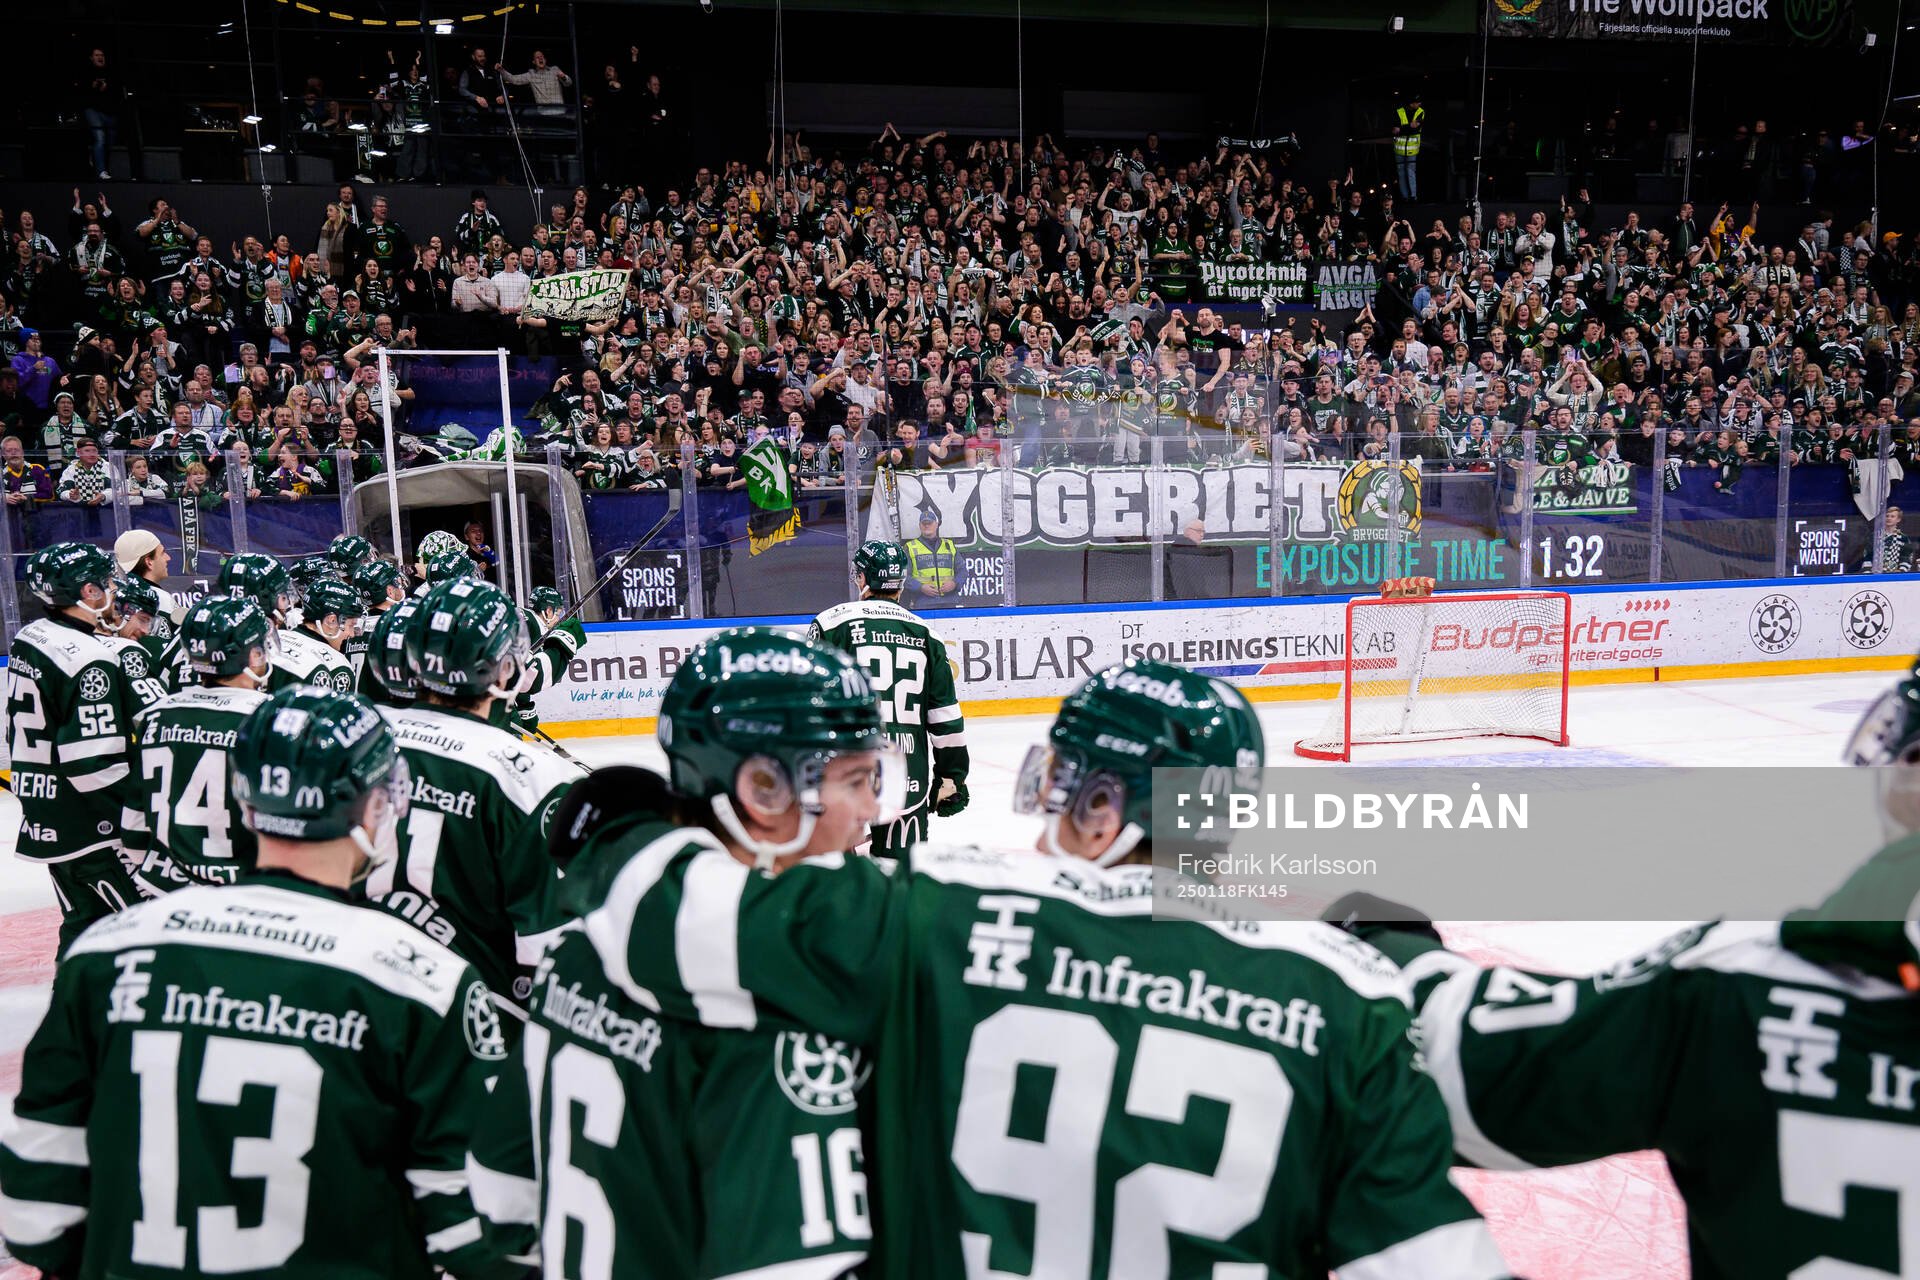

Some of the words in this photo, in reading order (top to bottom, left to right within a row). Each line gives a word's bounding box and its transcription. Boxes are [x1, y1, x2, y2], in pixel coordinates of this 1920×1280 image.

[1599, 22, 1640, 33] Färjestads
[1641, 24, 1673, 35] officiella
[1674, 27, 1731, 36] supporterklubb
[1199, 261, 1307, 284] Pyroteknik
[1318, 261, 1377, 286] AVGÅ
[537, 272, 622, 299] KARLSTAD
[1207, 283, 1224, 297] är
[1228, 284, 1263, 300] inget
[1267, 283, 1304, 298] brott
[1554, 489, 1569, 507] &
[1800, 530, 1840, 549] SPONS
[965, 557, 1004, 576] PONS
[1431, 539, 1506, 581] TIME
[1540, 535, 1604, 578] 1.32
[1799, 548, 1839, 567] WATCH
[622, 567, 675, 588] SPONS
[888, 563, 900, 574] 22
[171, 592, 203, 609] ONS
[229, 585, 245, 602] 75
[623, 587, 677, 608] WATCH
[1849, 593, 1888, 610] FLÄKT
[1756, 597, 1796, 614] FLÄKT
[1121, 623, 1142, 640] DT
[1367, 632, 1396, 653] AB
[1431, 615, 1669, 653] Budpartner
[1753, 630, 1797, 651] TEKNIK
[1845, 626, 1889, 647] TEKNIK
[190, 638, 207, 654] 34
[424, 652, 445, 674] 71
[567, 653, 648, 683] ema
[719, 645, 812, 675] Lecab
[386, 665, 401, 682] 11
[856, 645, 928, 725] 22
[131, 677, 169, 705] 98
[570, 688, 597, 702] Vart
[600, 688, 614, 701] är
[617, 687, 634, 700] du
[638, 687, 653, 702] på
[8, 673, 53, 765] 2
[78, 703, 117, 737] 52
[160, 724, 238, 749] Infrakraft
[393, 729, 465, 752] aktmiljö
[259, 763, 291, 798] 13
[141, 746, 234, 858] 34
[163, 909, 338, 953] Schaktmiljö
[1045, 946, 1326, 1057] Infrakraft
[161, 984, 370, 1051] Infrakraft
[130, 1030, 325, 1274] 13
[950, 1003, 1295, 1280] 92
[790, 1127, 873, 1249] 16
